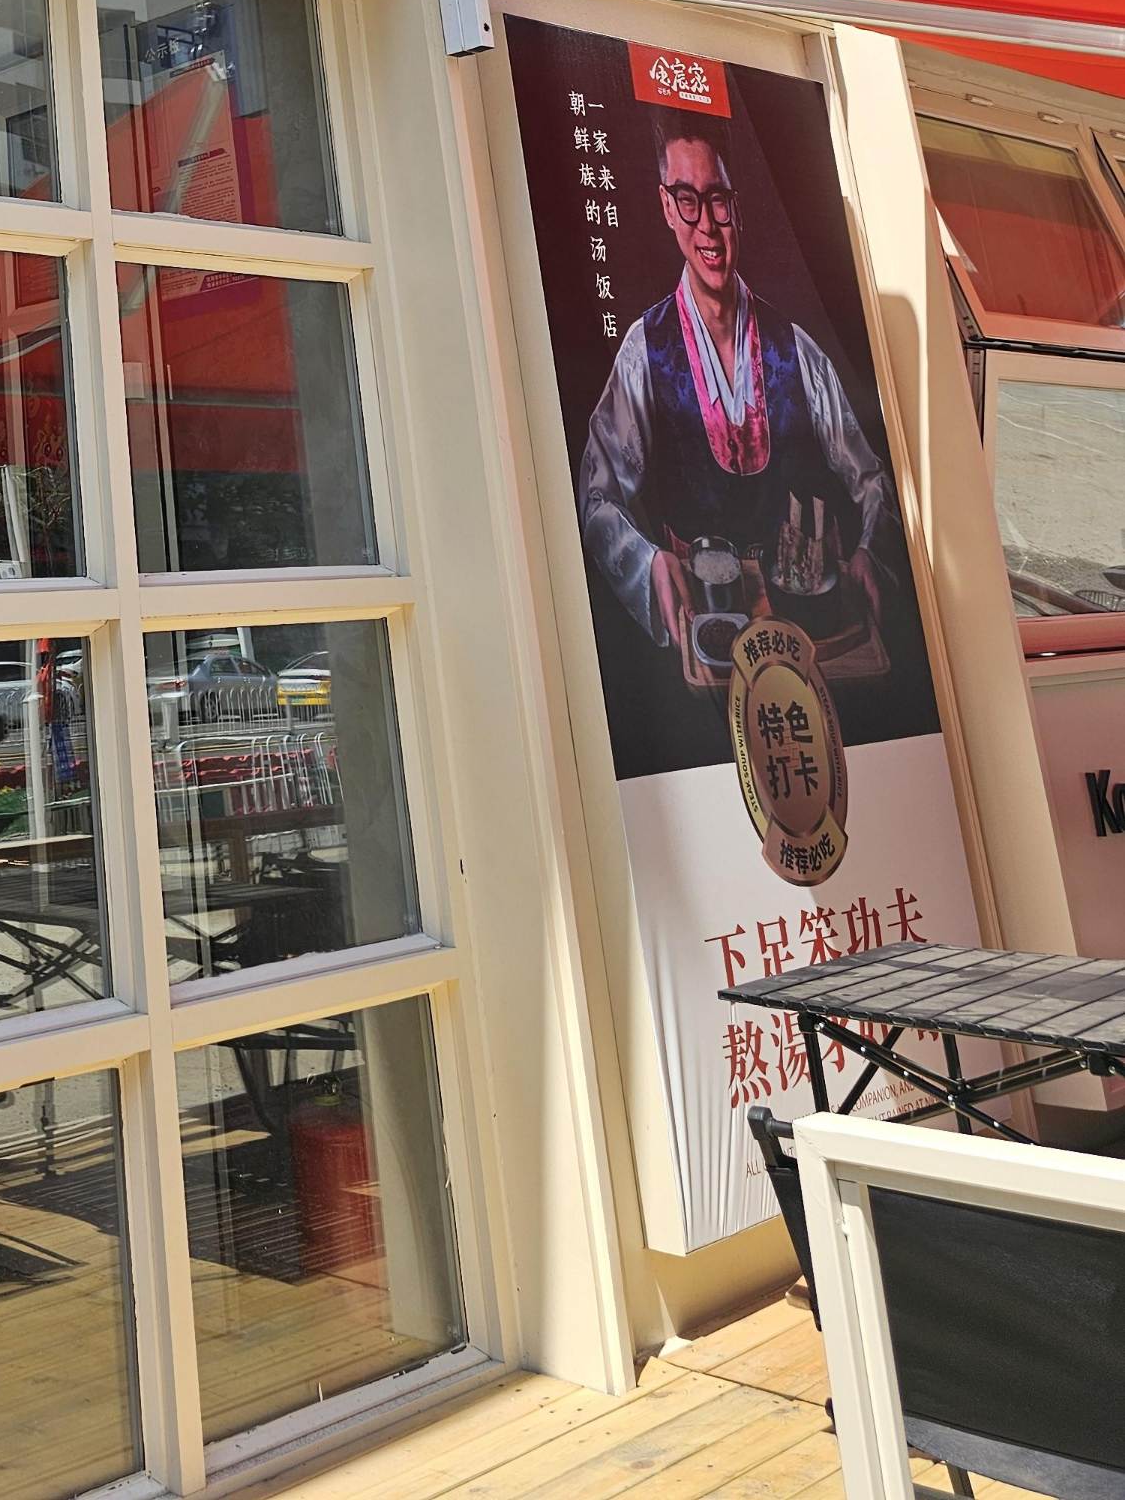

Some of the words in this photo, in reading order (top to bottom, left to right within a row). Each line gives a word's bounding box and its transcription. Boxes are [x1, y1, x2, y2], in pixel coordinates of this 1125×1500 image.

[587, 101, 620, 228] 一家来自
[568, 90, 618, 338] 朝鲜族的汤饭店
[743, 629, 801, 667] 推荐必吃
[736, 720, 744, 748] WITH
[757, 701, 813, 749] 特色
[740, 750, 749, 779] SOUP
[766, 751, 818, 799] 打卡
[746, 781, 759, 812] STEAK
[779, 832, 835, 874] 推荐必吃
[704, 887, 928, 990] 下足笨功夫
[852, 1084, 899, 1112] OMPANION,
